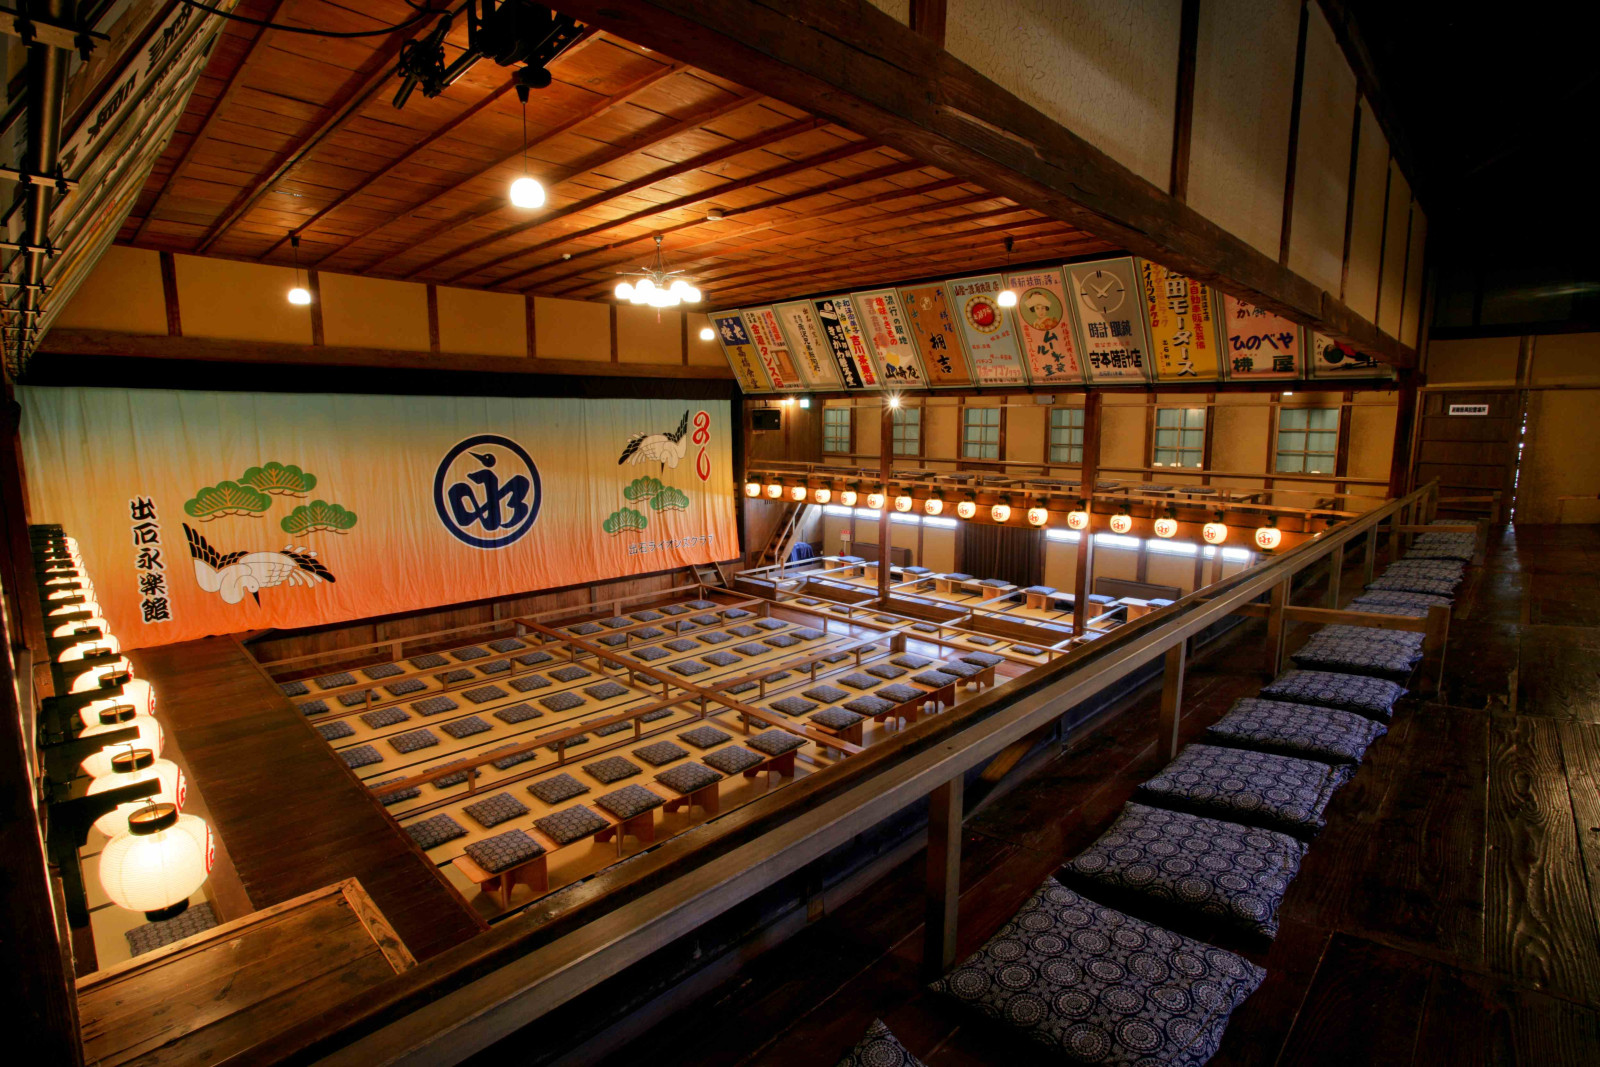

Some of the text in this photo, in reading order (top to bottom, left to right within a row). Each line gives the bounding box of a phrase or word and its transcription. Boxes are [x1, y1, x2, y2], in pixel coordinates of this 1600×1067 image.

[1088, 322, 1108, 338] 時計
[1089, 348, 1143, 368] 守本時計店
